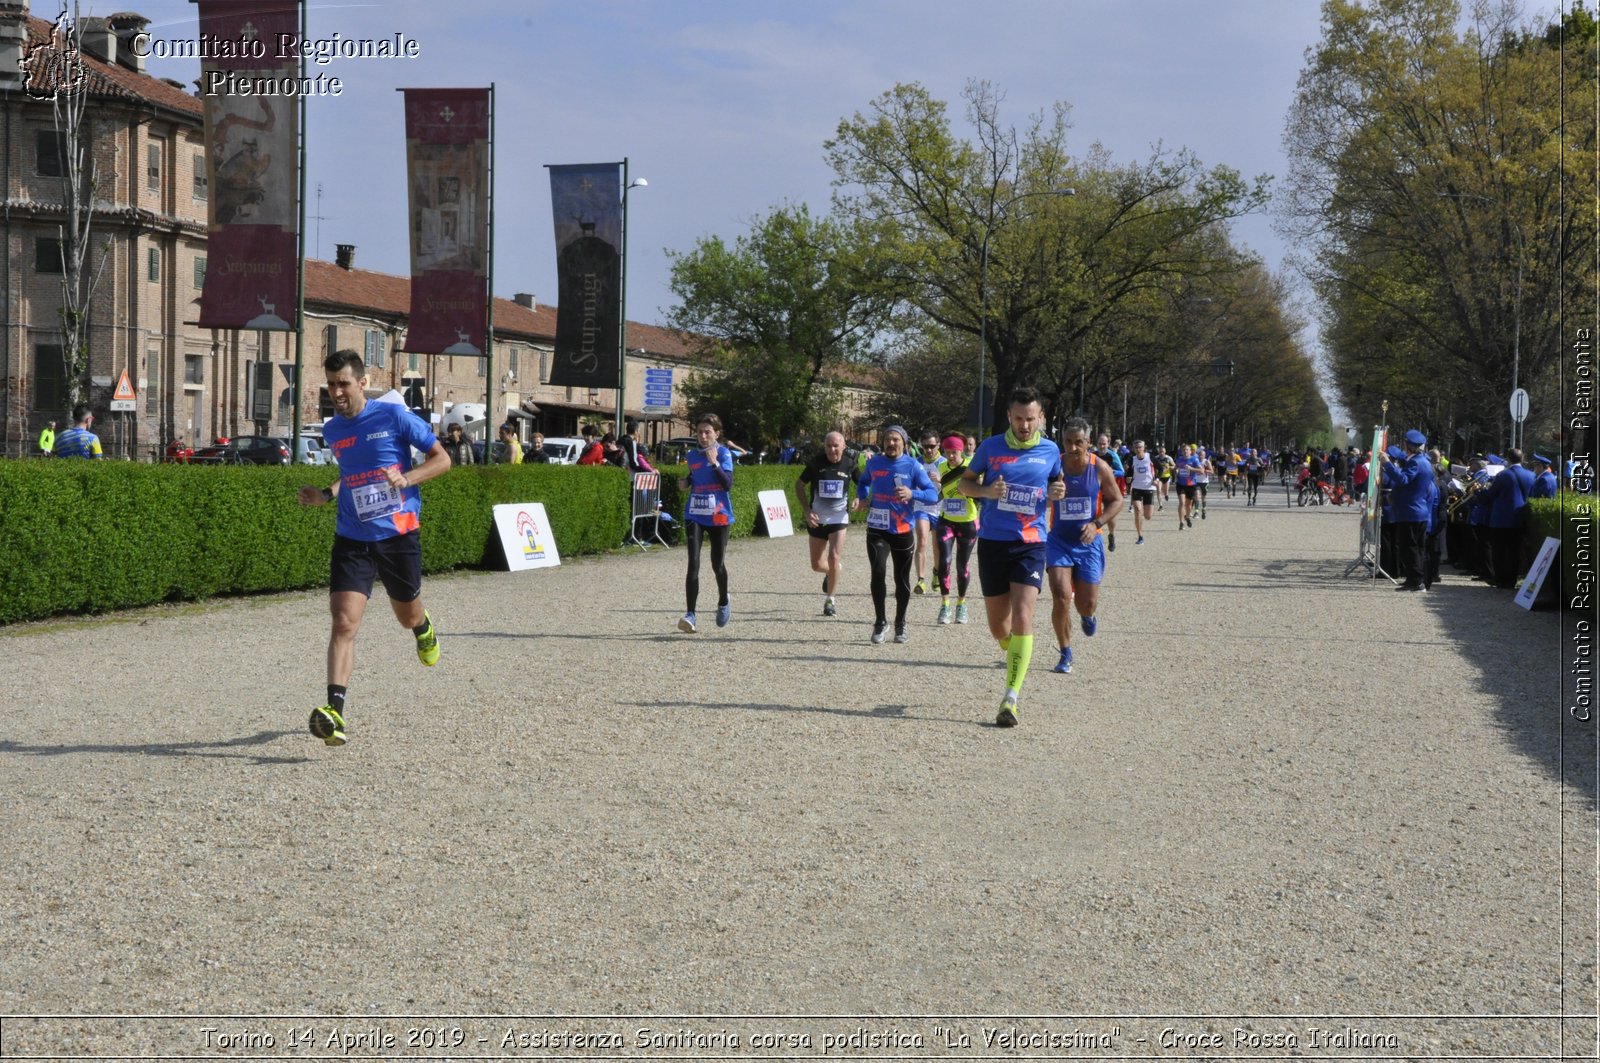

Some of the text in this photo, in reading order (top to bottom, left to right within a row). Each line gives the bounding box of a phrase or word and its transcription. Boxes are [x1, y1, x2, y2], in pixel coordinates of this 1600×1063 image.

[569, 273, 601, 374] Stupinigi
[365, 490, 388, 506] 2775
[1009, 490, 1030, 503] 1289
[767, 506, 788, 521] GIMAX
[1067, 502, 1083, 511] 599
